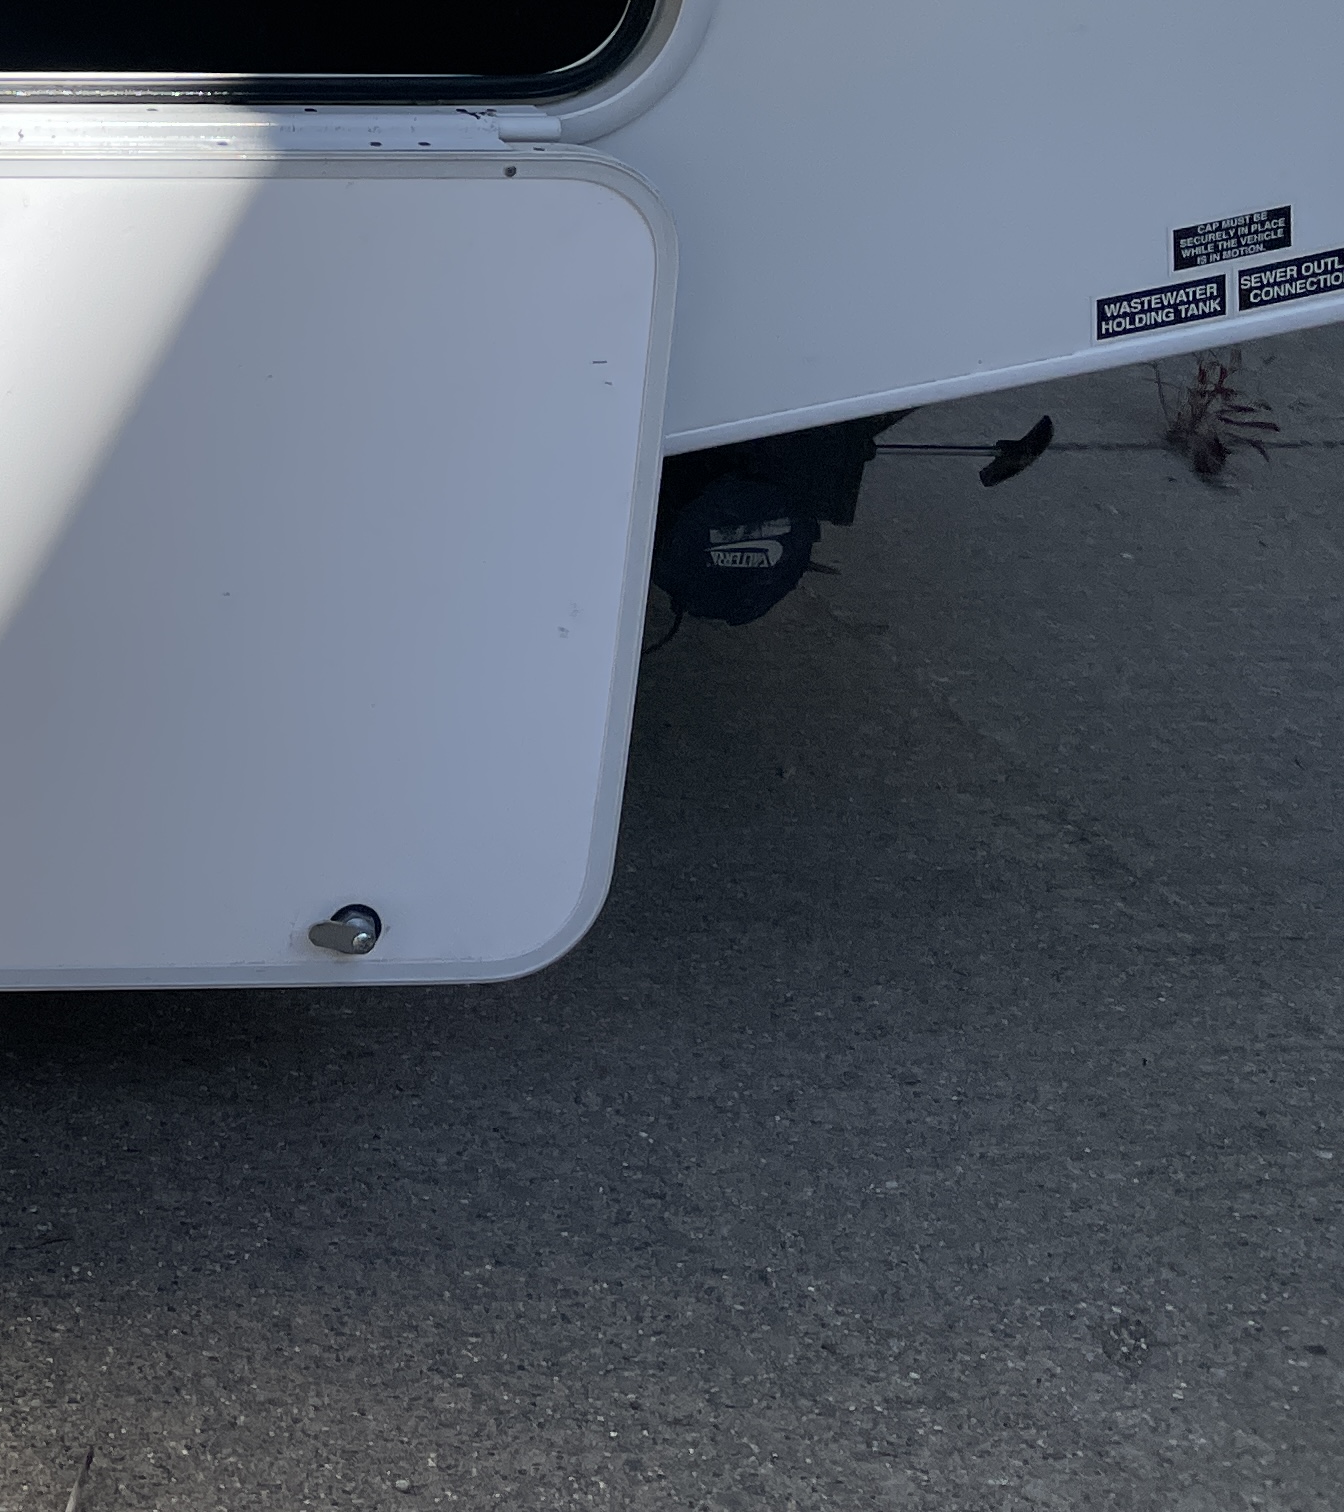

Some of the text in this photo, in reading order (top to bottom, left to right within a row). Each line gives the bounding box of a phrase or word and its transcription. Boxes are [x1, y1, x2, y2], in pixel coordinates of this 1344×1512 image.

[1180, 218, 1285, 248] SECURELY IN PLACE
[1198, 212, 1268, 234] CAP MUST BE
[1181, 229, 1284, 258] WHILE THE VEHICLE
[1197, 244, 1266, 265] IS IN MOTION.
[1241, 266, 1297, 289] SEWER
[1250, 272, 1344, 302] CONNECTIO
[1104, 283, 1217, 317] WASTEWATER
[1101, 298, 1221, 334] HOLDING TANK
